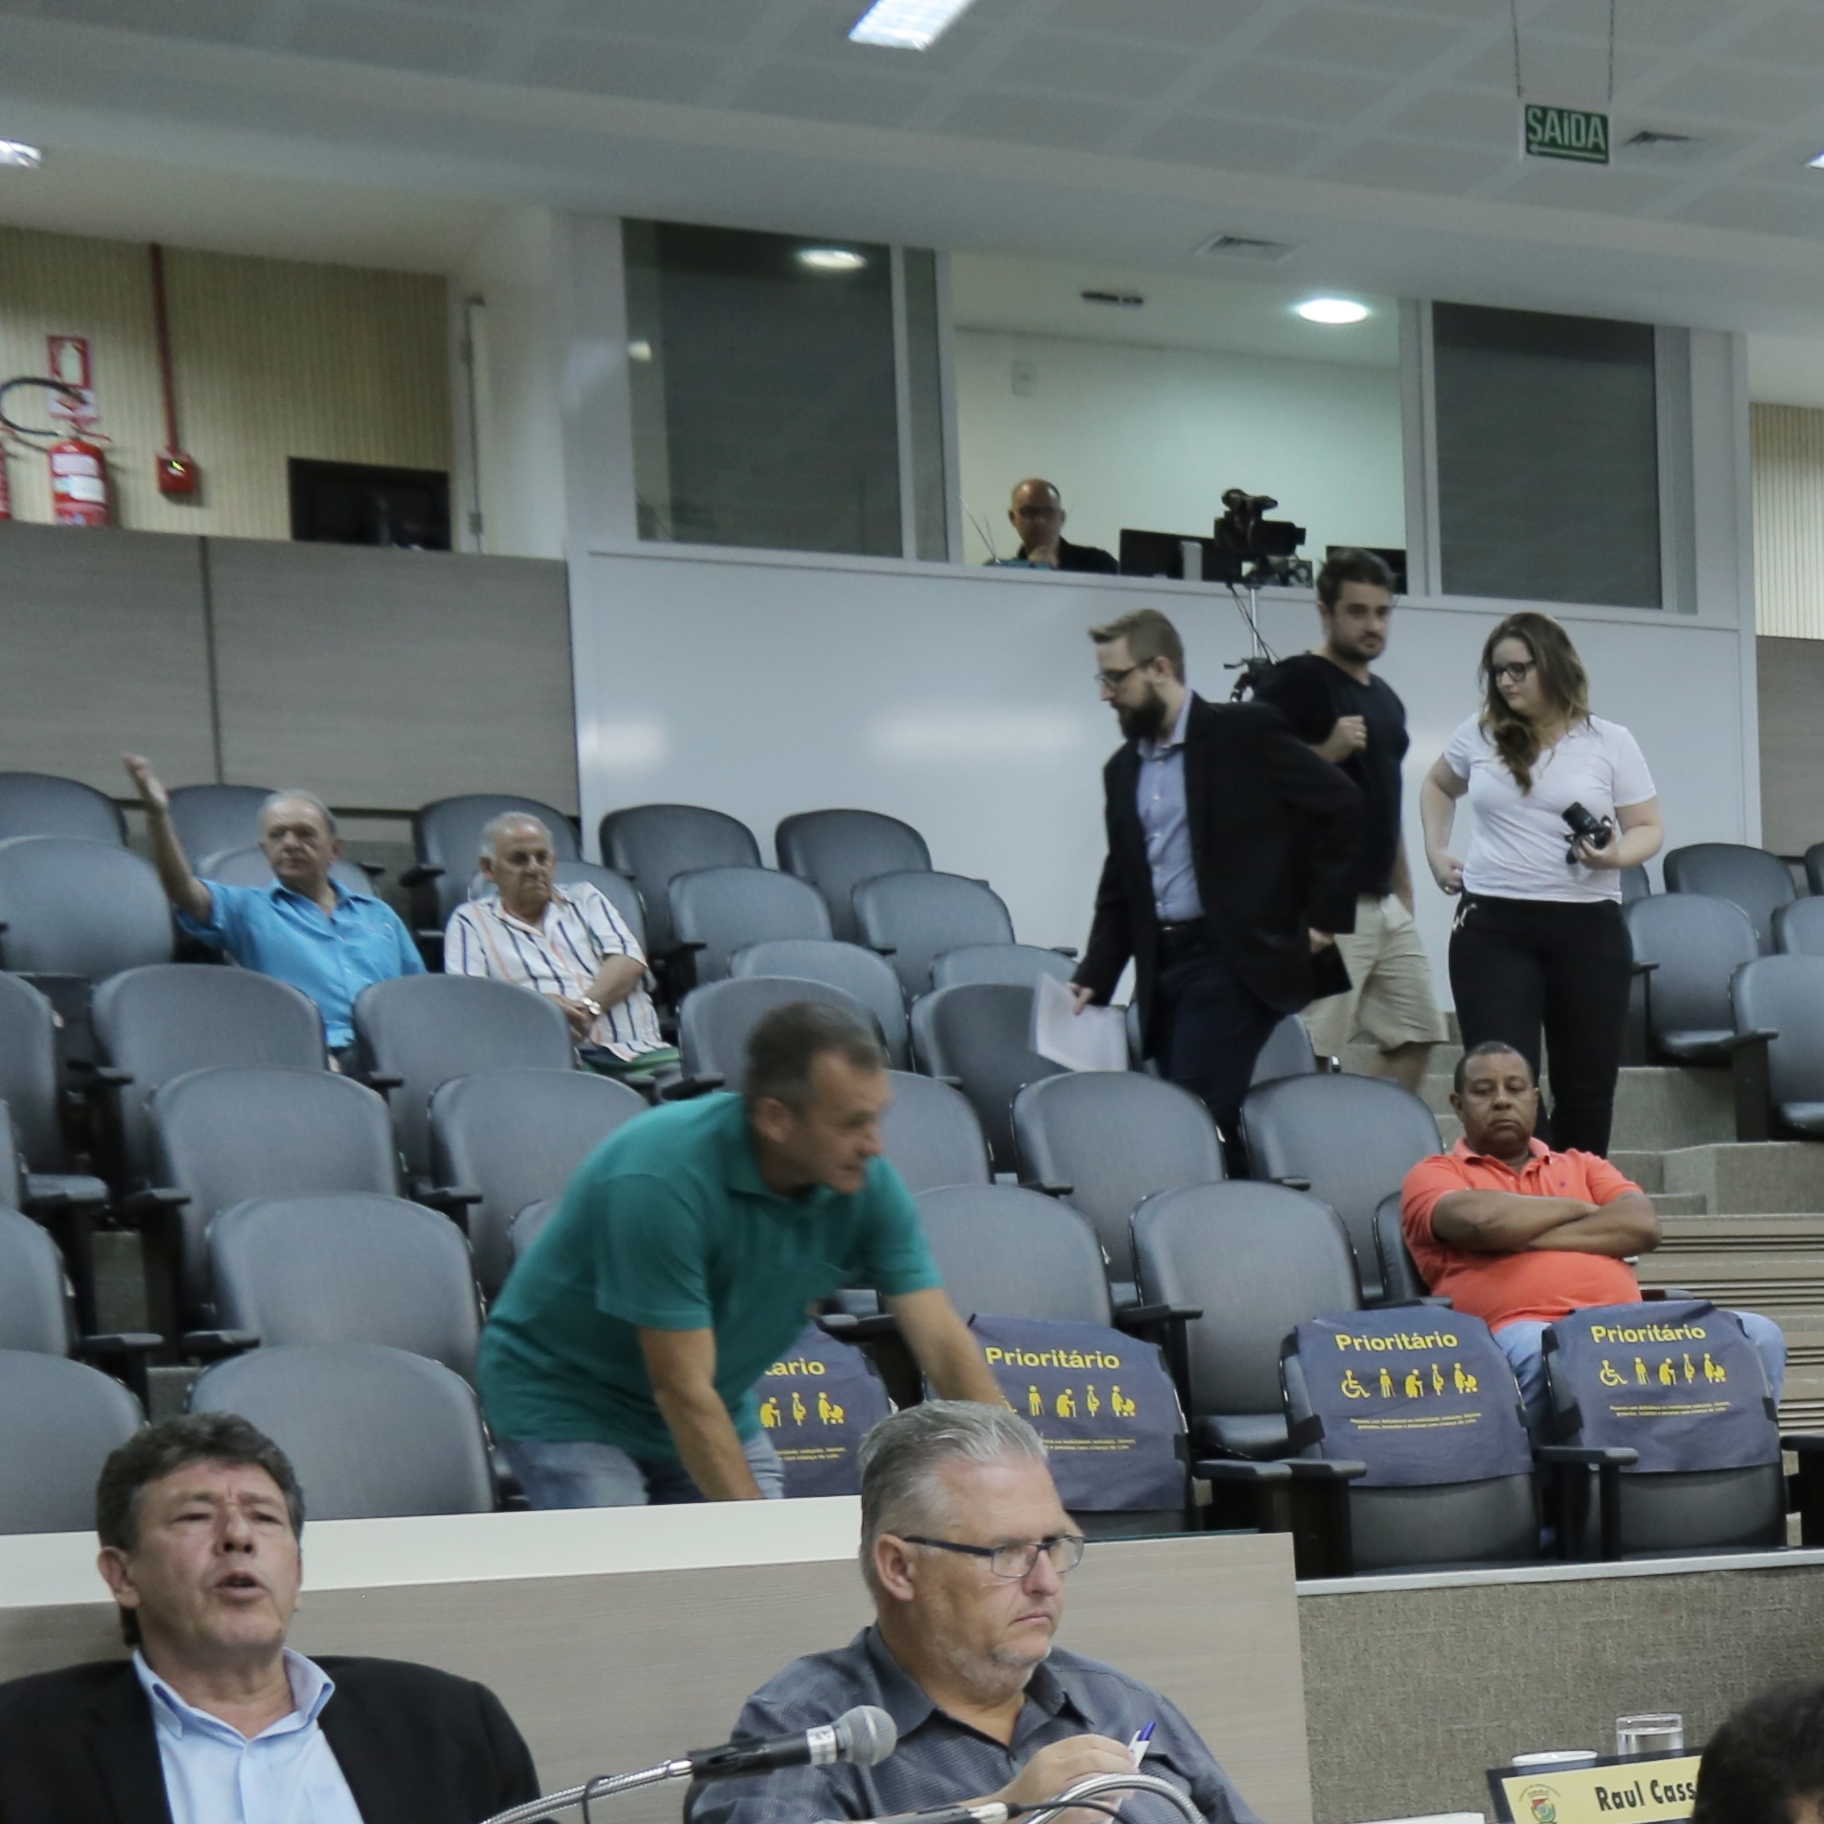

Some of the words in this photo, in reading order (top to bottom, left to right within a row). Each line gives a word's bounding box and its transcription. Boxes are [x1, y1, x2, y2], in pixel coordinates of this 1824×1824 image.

[1526, 107, 1606, 150] SAÍDA
[1334, 1330, 1460, 1352] Prioritário
[1590, 1323, 1708, 1344] Prioritário
[984, 1346, 1122, 1370] Prioritário
[1594, 1780, 1645, 1812] Raul
[1649, 1778, 1697, 1805] Cass
